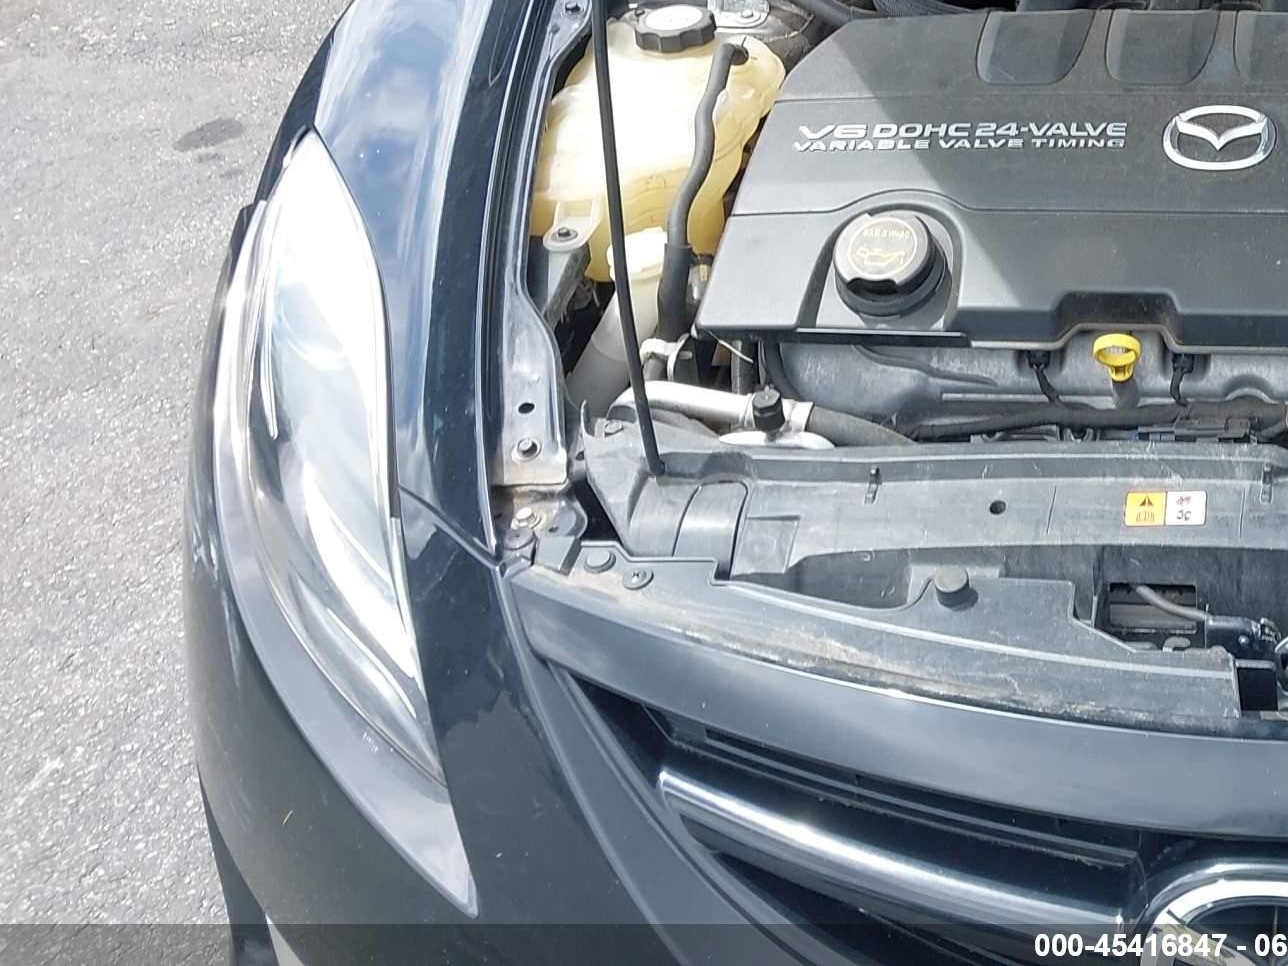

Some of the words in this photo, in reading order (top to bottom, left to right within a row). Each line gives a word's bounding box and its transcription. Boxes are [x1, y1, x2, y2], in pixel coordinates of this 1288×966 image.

[799, 123, 868, 139] V6
[872, 122, 971, 138] DOHC
[975, 122, 1128, 137] 24-VALVE
[793, 139, 931, 152] VARIABLE
[938, 138, 1024, 150] VALVE
[1031, 138, 1126, 149] TIMING
